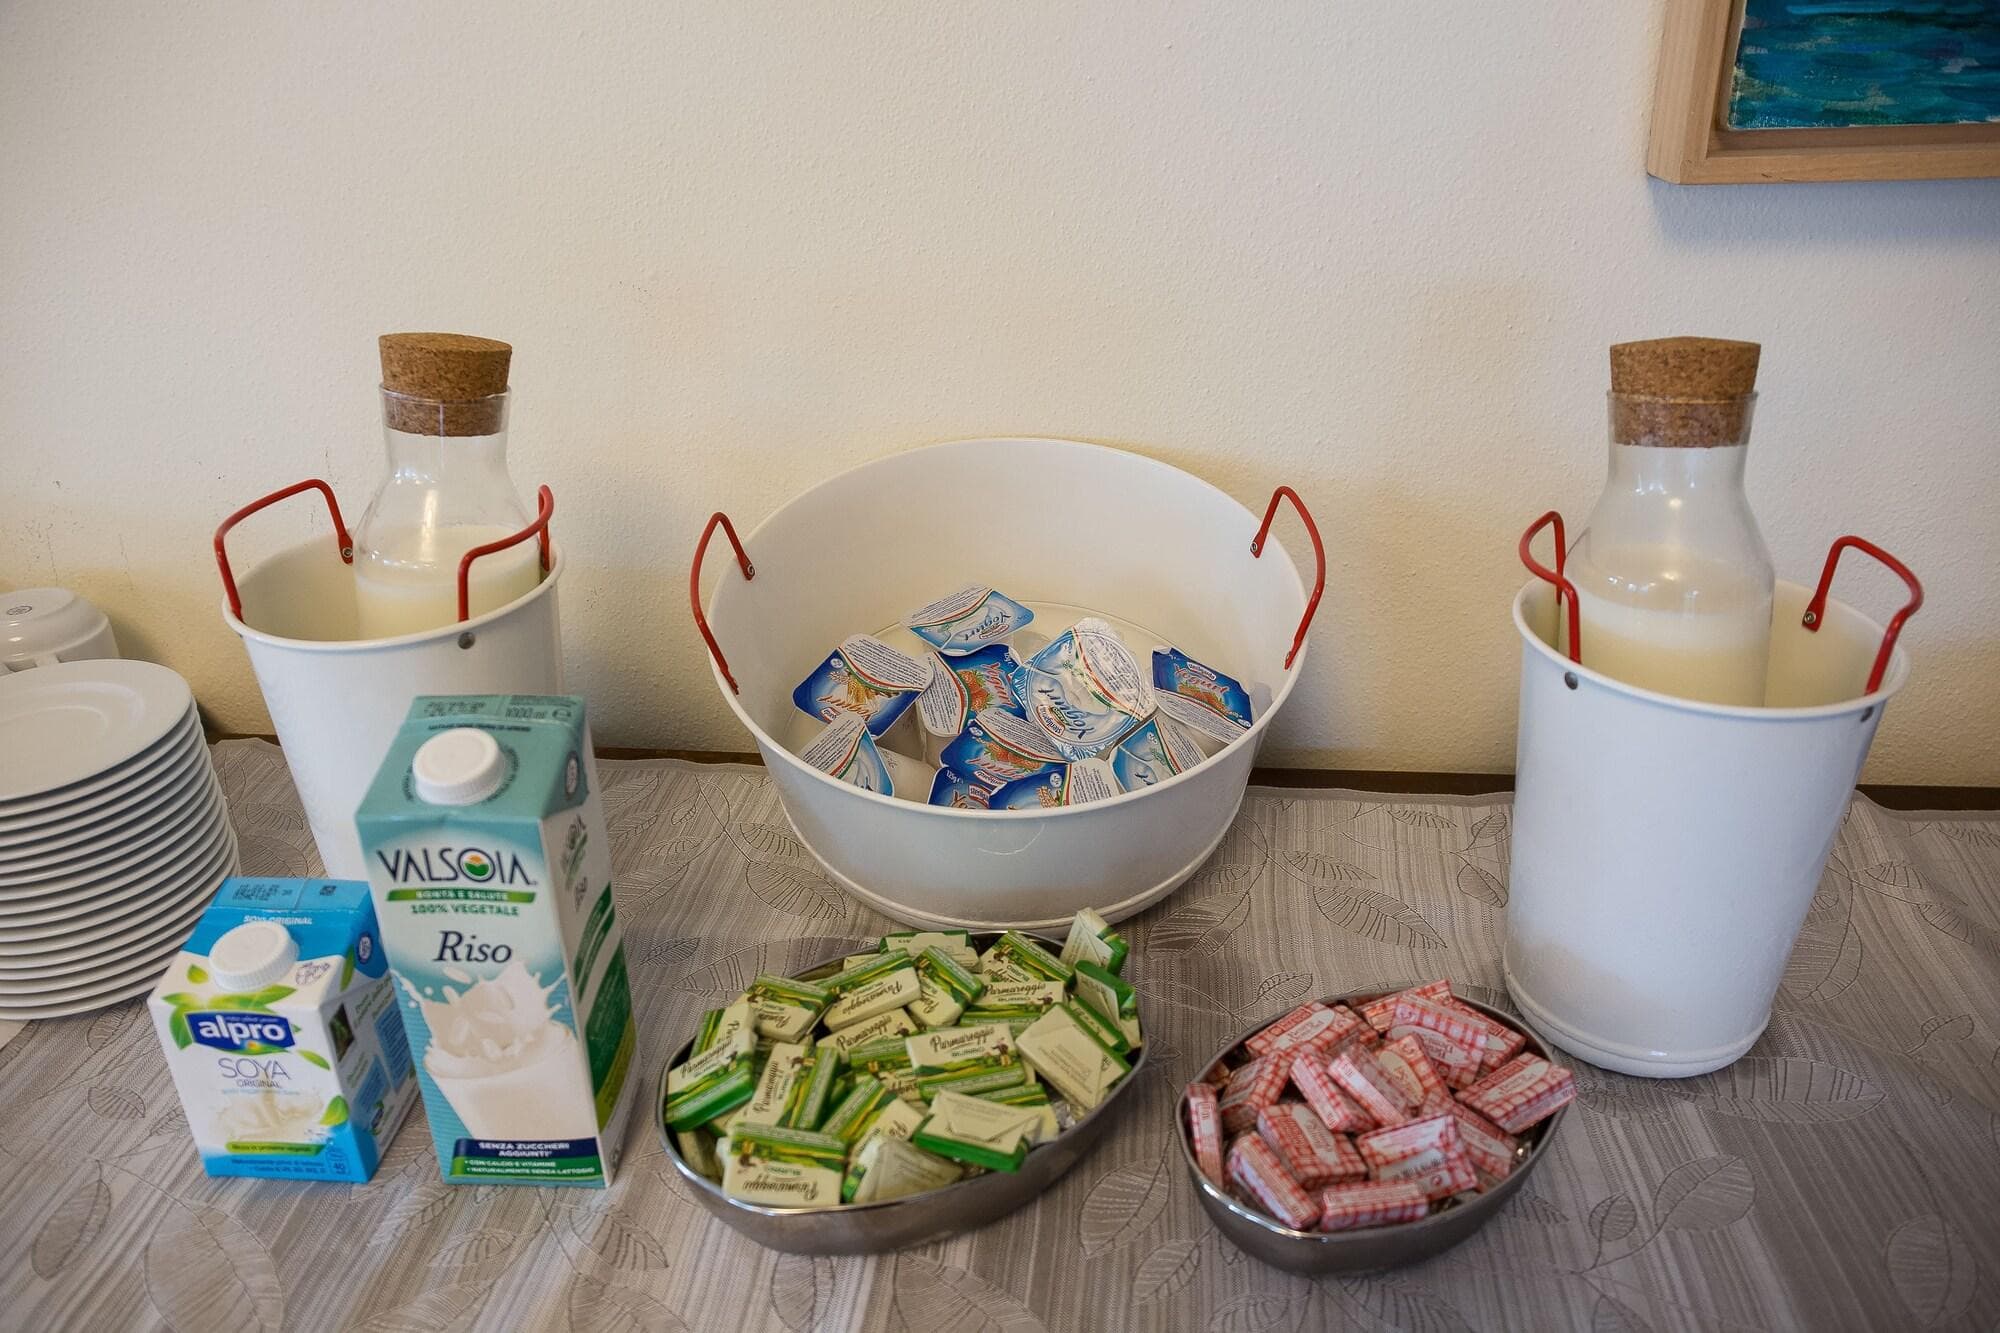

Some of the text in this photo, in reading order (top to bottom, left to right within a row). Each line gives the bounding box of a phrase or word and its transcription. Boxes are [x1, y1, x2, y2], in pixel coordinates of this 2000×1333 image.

[1038, 688, 1095, 740] Yogurt
[376, 848, 531, 885] VALSOIA
[411, 904, 519, 916] 100% VEGETALE
[432, 930, 513, 963] Riso
[984, 983, 1046, 997] Parmareggio
[198, 1015, 286, 1045] alpro
[930, 1025, 994, 1053] Parmareggio
[218, 1058, 291, 1080] SOYA
[479, 1142, 570, 1150] SENZA ZUCCHERI
